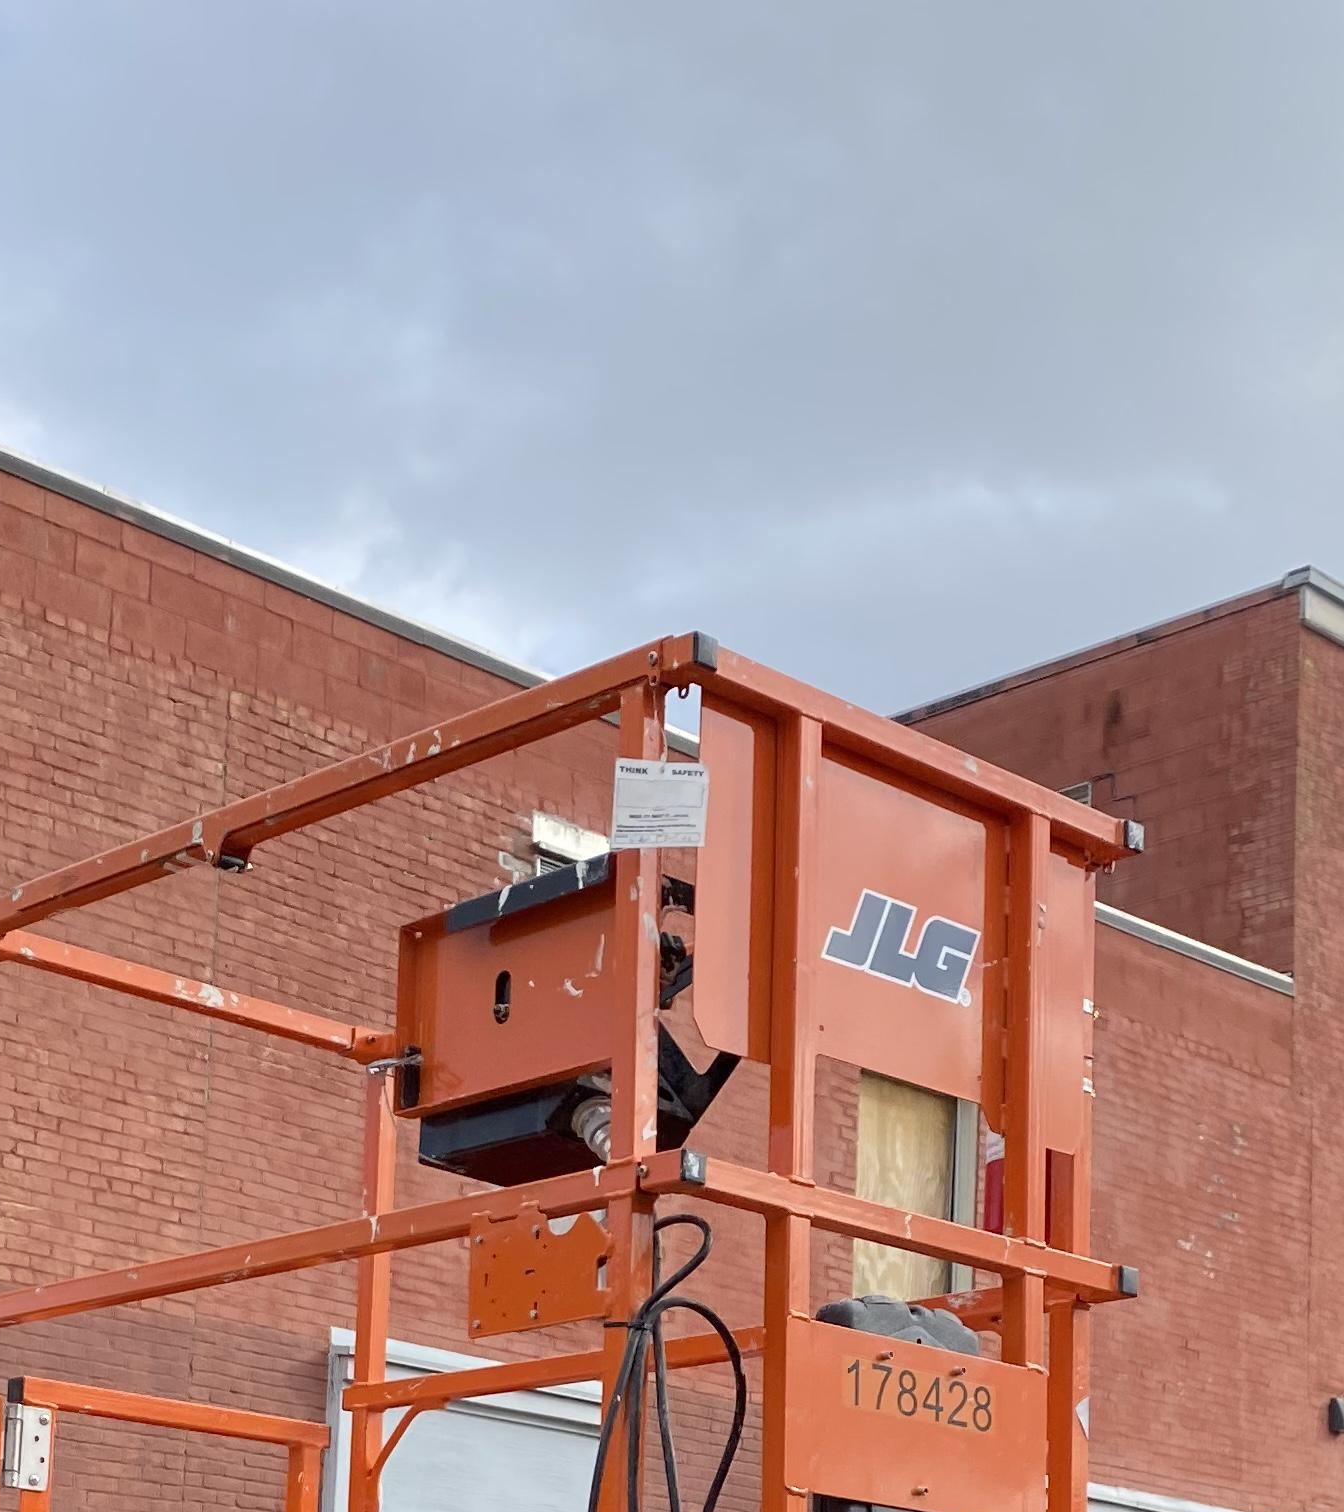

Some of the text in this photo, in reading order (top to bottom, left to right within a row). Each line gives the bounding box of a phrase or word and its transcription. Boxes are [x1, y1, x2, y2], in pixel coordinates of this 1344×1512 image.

[619, 766, 705, 777] THINK SAFETY
[821, 888, 981, 1004] JLG
[847, 1359, 992, 1432] 178428
